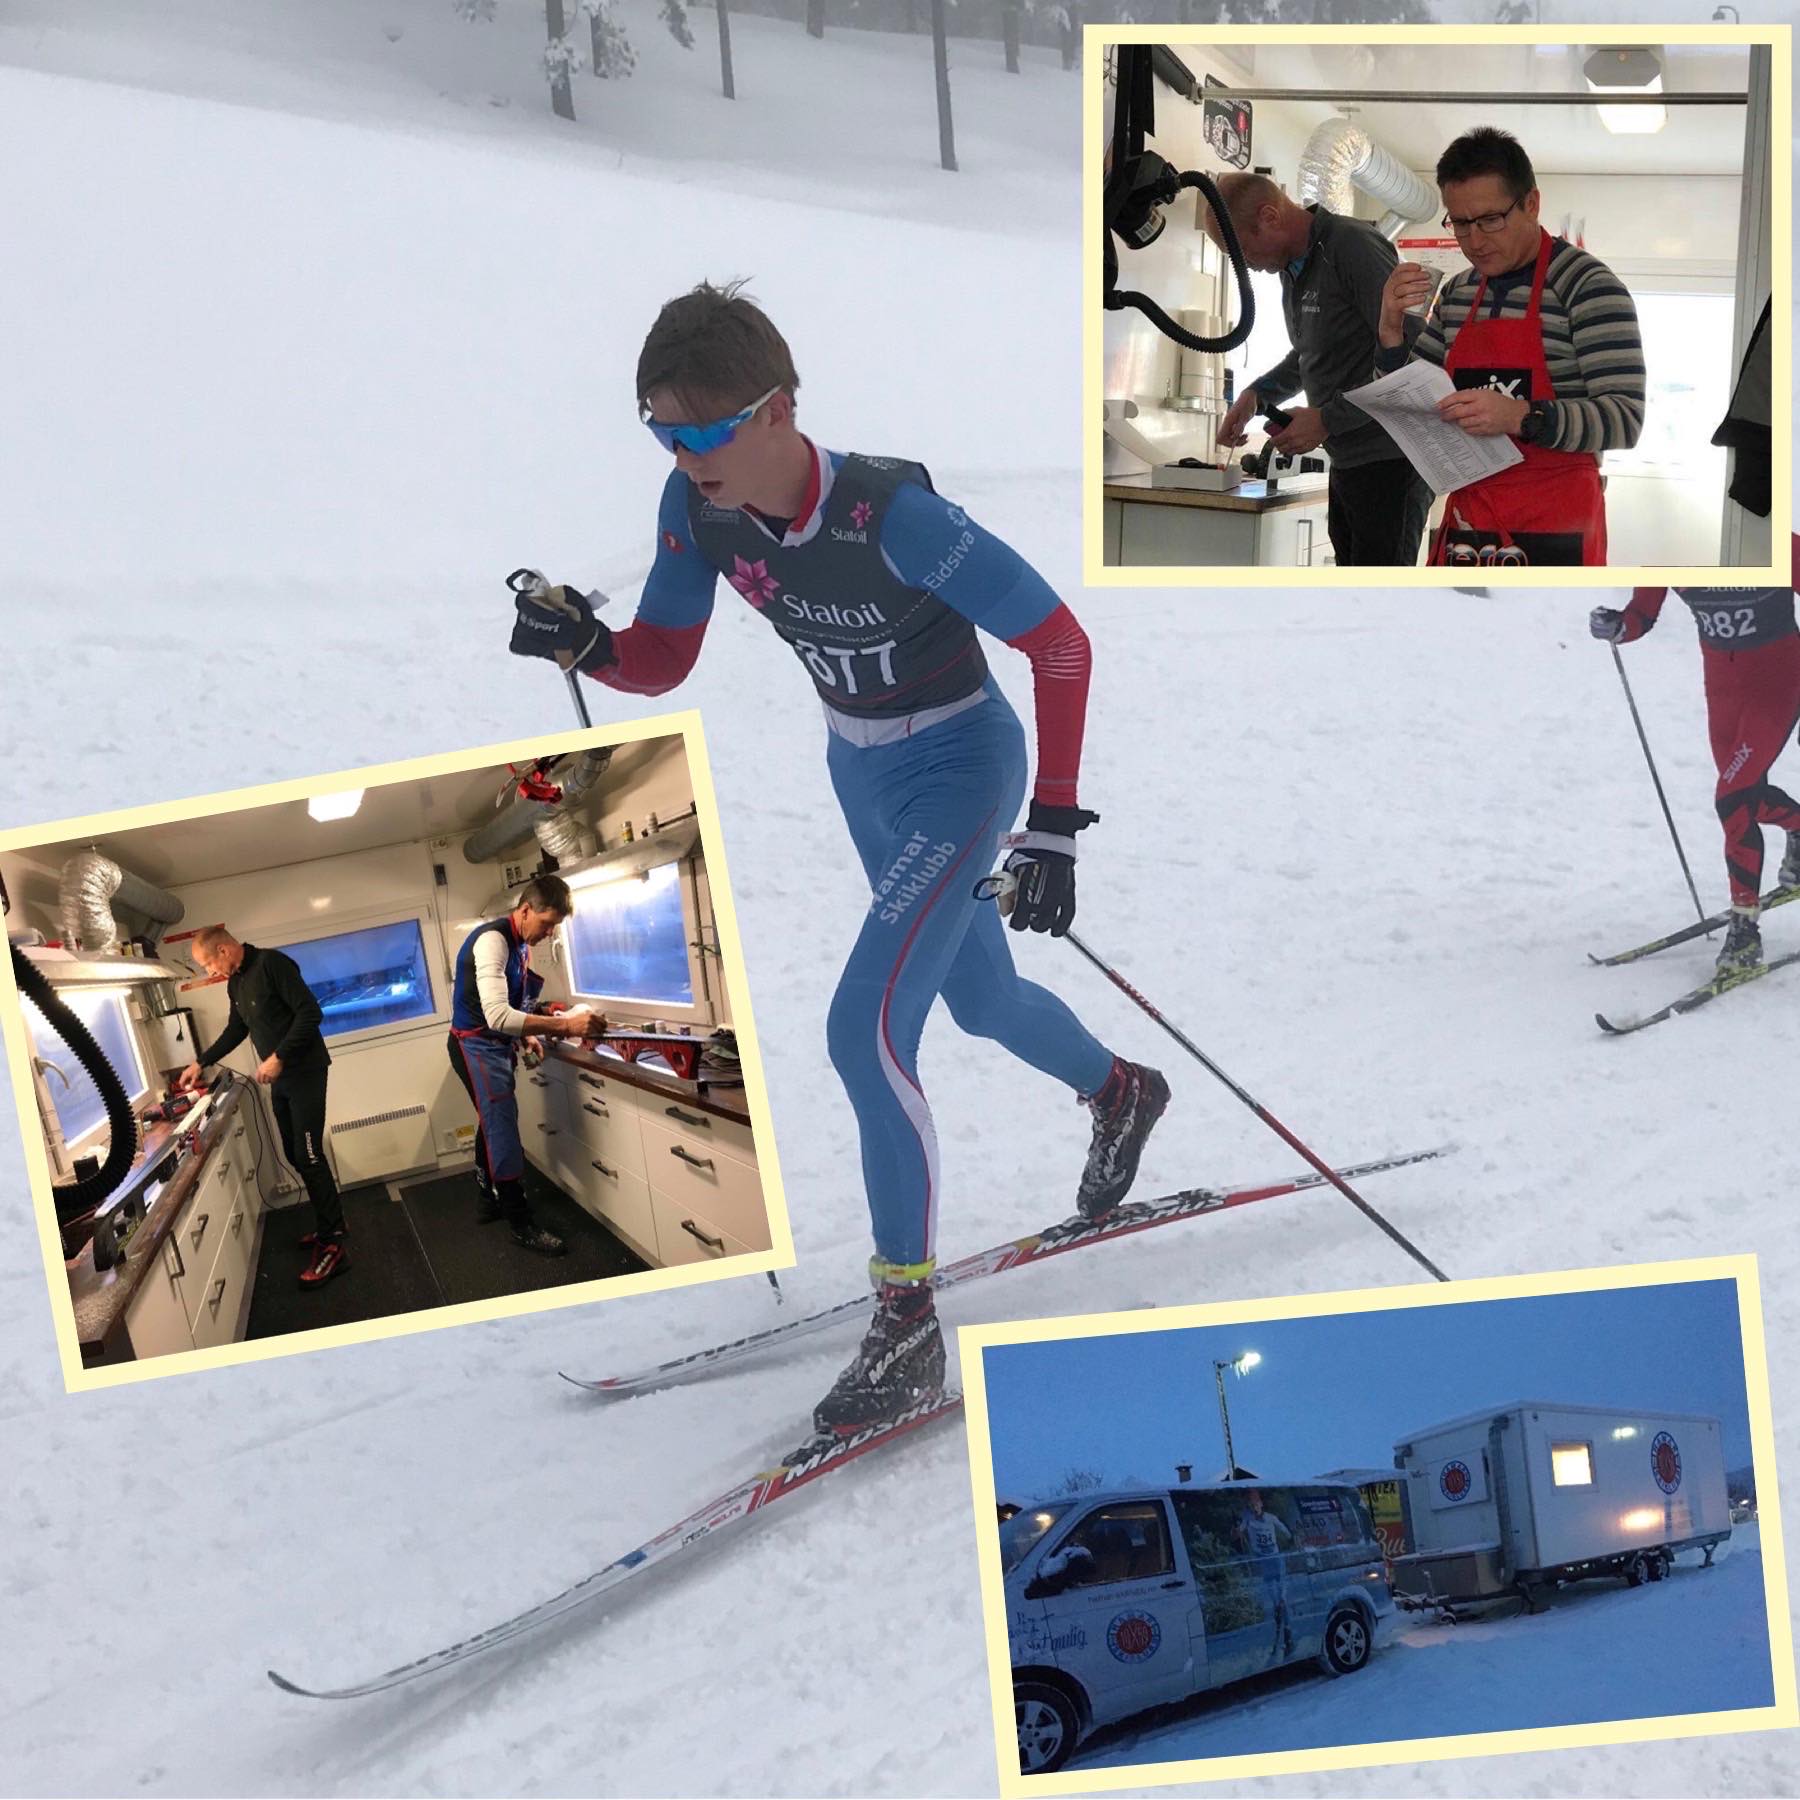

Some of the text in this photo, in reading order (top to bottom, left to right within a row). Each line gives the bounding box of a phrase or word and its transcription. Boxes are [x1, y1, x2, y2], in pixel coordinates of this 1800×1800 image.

[831, 527, 867, 544] Statoil
[922, 530, 975, 590] Eidsiva
[783, 594, 887, 628] Statoil
[1697, 608, 1757, 638] 882
[880, 842, 956, 924] Skiklubb
